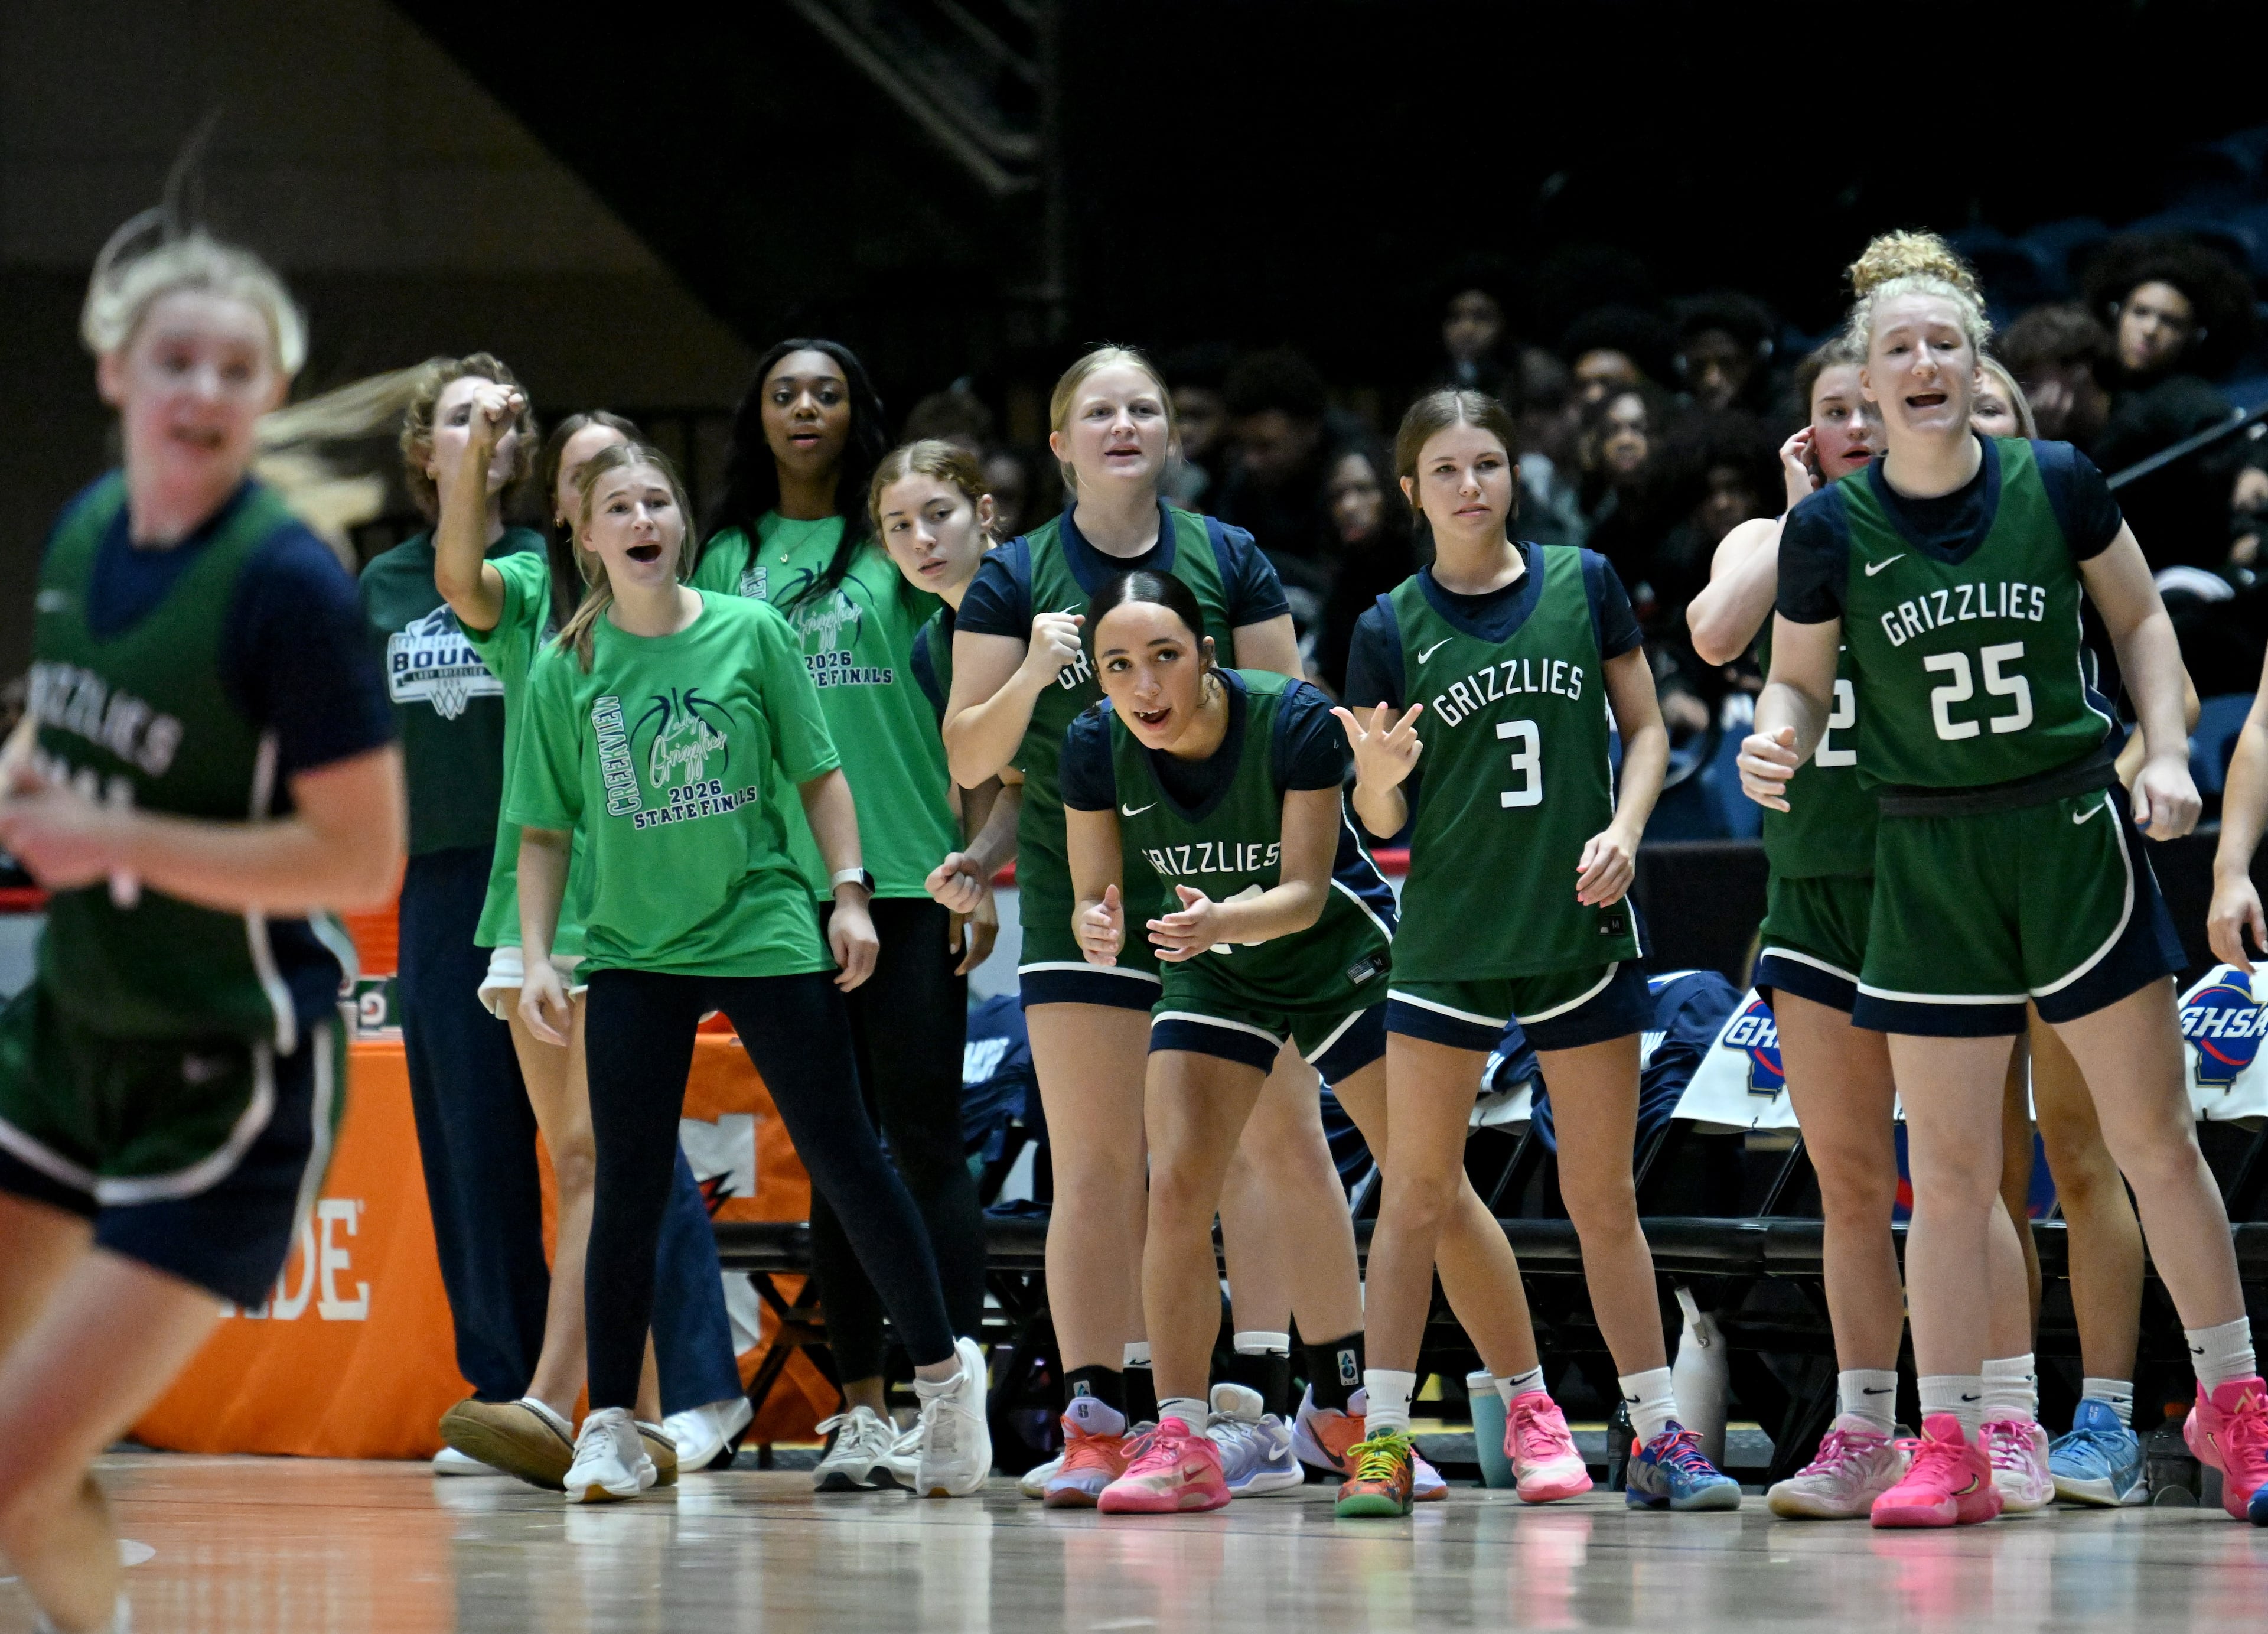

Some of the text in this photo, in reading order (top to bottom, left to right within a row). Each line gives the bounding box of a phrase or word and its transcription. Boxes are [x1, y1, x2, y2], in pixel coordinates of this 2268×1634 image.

[1880, 582, 2047, 647] GRIZZLIES
[393, 647, 483, 673] BOUN
[804, 650, 851, 671] 2026
[1432, 659, 1583, 728] GRIZZLIES
[1923, 641, 2034, 741] 25
[650, 720, 728, 788] Grizzlies
[1495, 719, 1543, 808] 3
[669, 779, 721, 804] 2026
[1725, 1016, 1780, 1049] GH
[2179, 1007, 2268, 1038] GHSA
